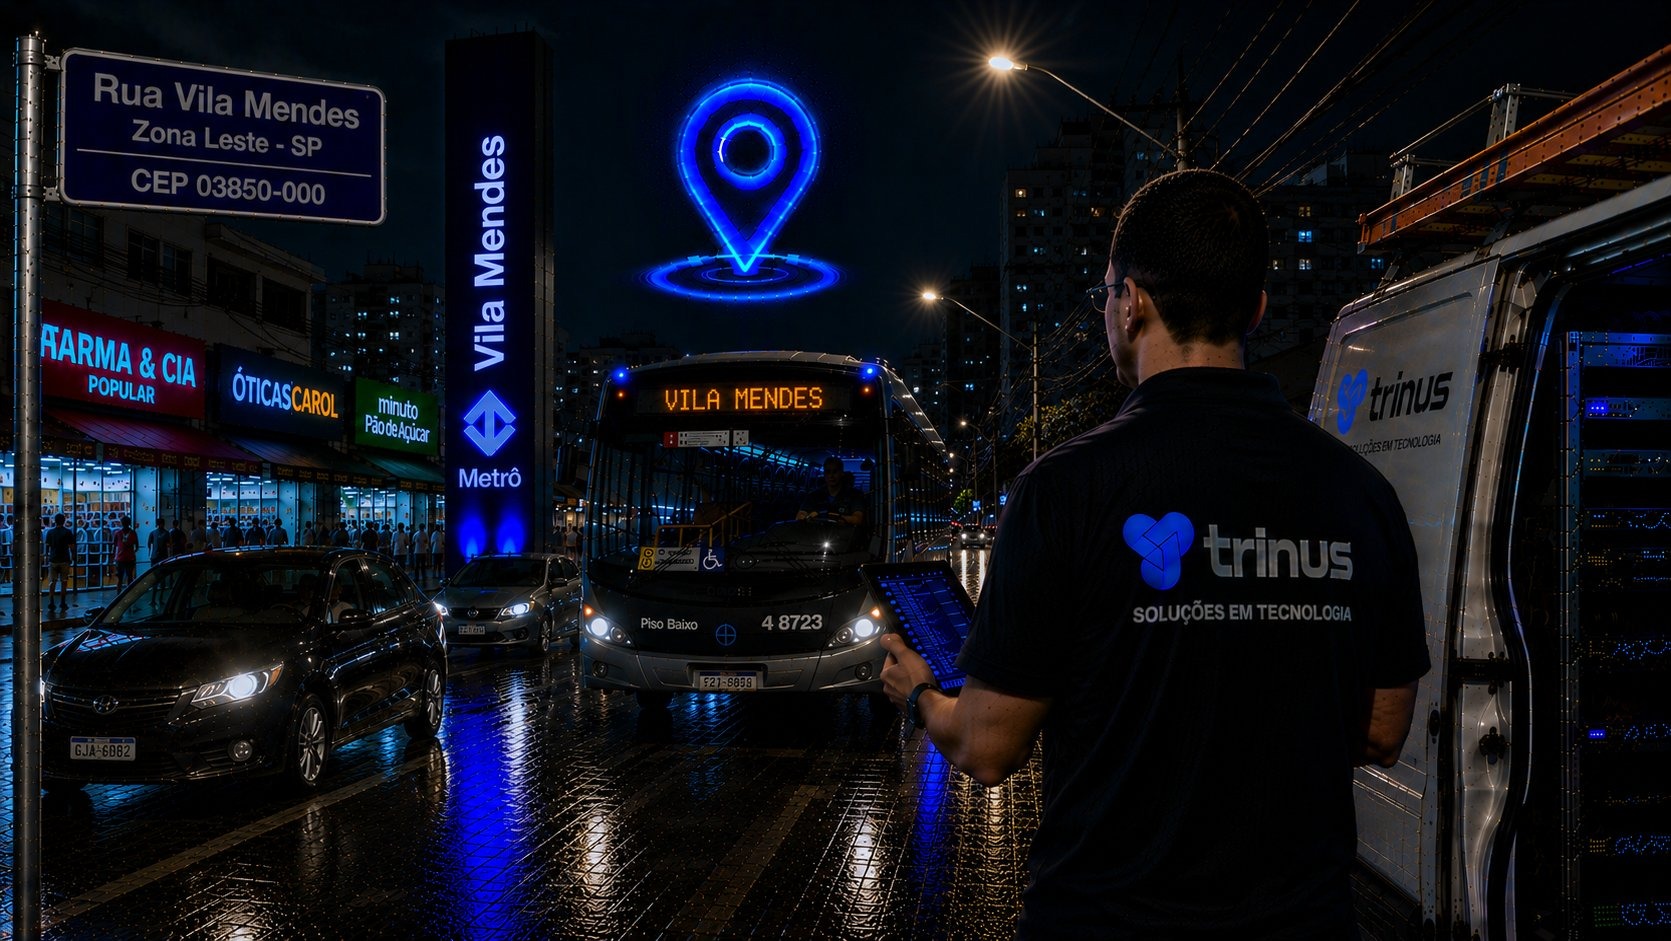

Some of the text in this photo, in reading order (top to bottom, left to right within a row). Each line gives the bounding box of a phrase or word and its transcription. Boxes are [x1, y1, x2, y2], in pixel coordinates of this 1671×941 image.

[94, 73, 360, 129] Rua Vila Mendes
[132, 120, 196, 147] Zona
[205, 127, 268, 154] Leste
[291, 135, 322, 157] SP
[131, 169, 325, 205] CEP 03850-000
[473, 135, 505, 372] Vila Mendes
[139, 347, 156, 380] &
[162, 352, 196, 388] CIA
[88, 374, 155, 405] POPULAR
[665, 386, 823, 411] VILA MENDES
[1369, 371, 1453, 422] trinus
[378, 395, 418, 420] minuto
[365, 414, 385, 435] Pão
[386, 419, 398, 438] de
[1393, 434, 1441, 450] TECNOLOGIA
[458, 467, 522, 489] Metrô
[1203, 523, 1353, 581] trinus
[640, 617, 698, 631] Piso Baixo
[761, 614, 823, 631] 4 8723
[1132, 600, 1352, 625] SOLUÇÕES EM TECNOLOGIA
